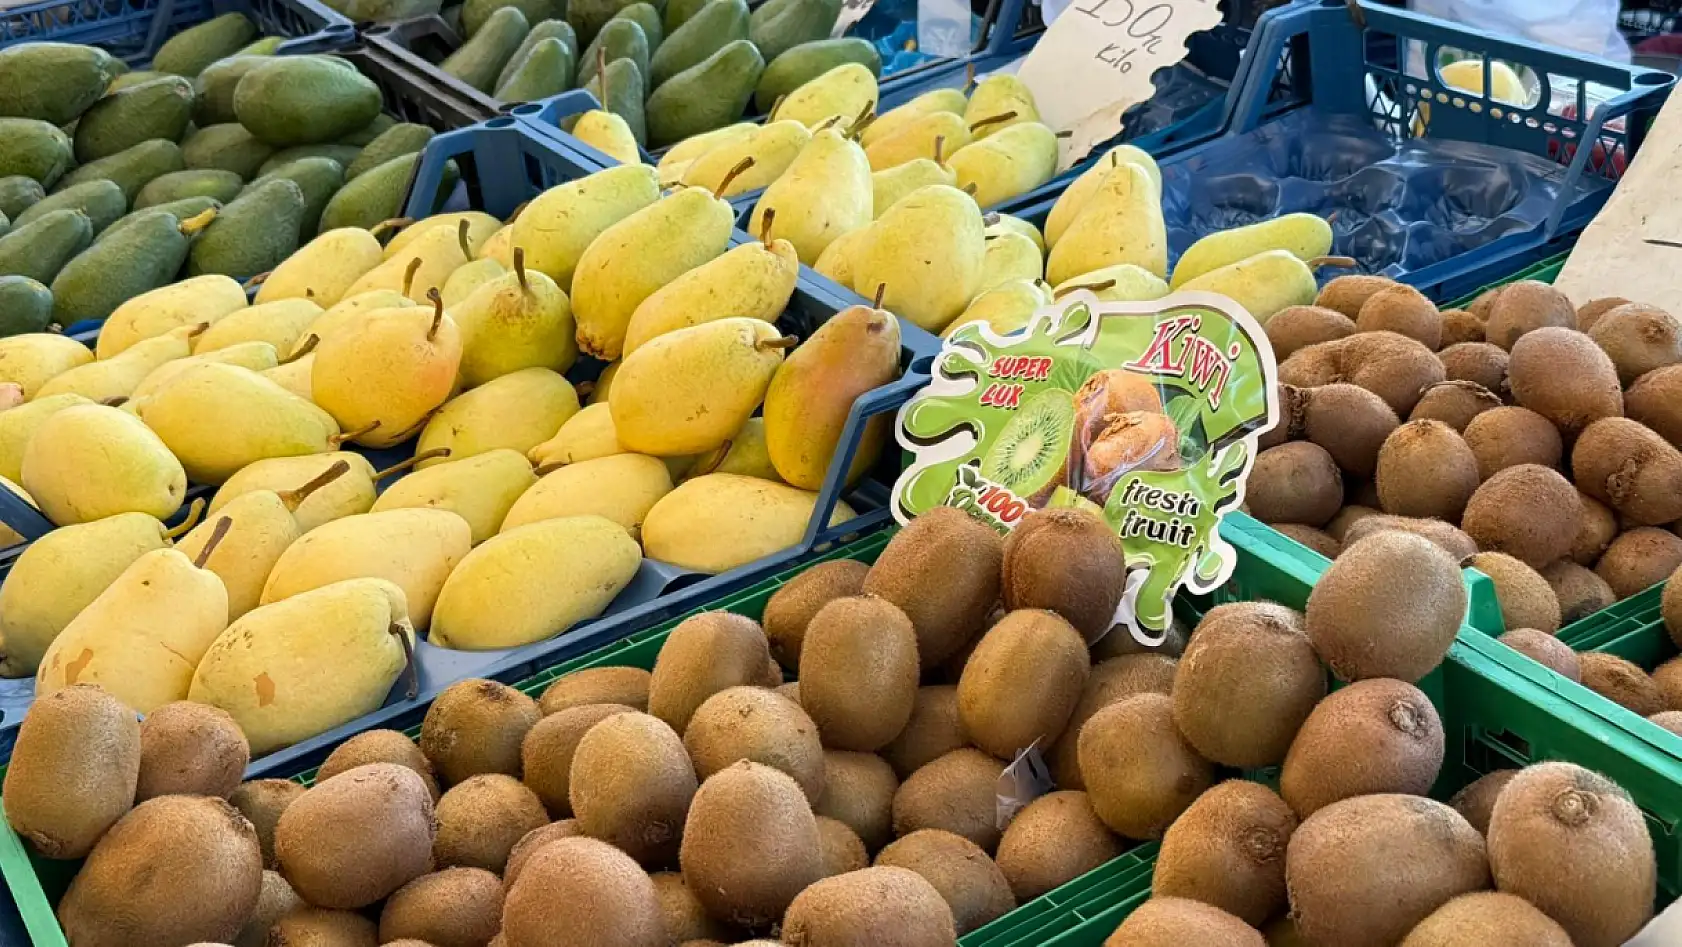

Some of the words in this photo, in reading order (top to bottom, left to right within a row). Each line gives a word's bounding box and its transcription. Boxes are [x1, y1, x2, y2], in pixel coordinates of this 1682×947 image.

[989, 356, 1052, 380] SUPER
[1122, 315, 1240, 412] Kiwi
[980, 383, 1025, 408] LUX
[1121, 478, 1198, 516] fresh
[1120, 509, 1194, 545] fruit
